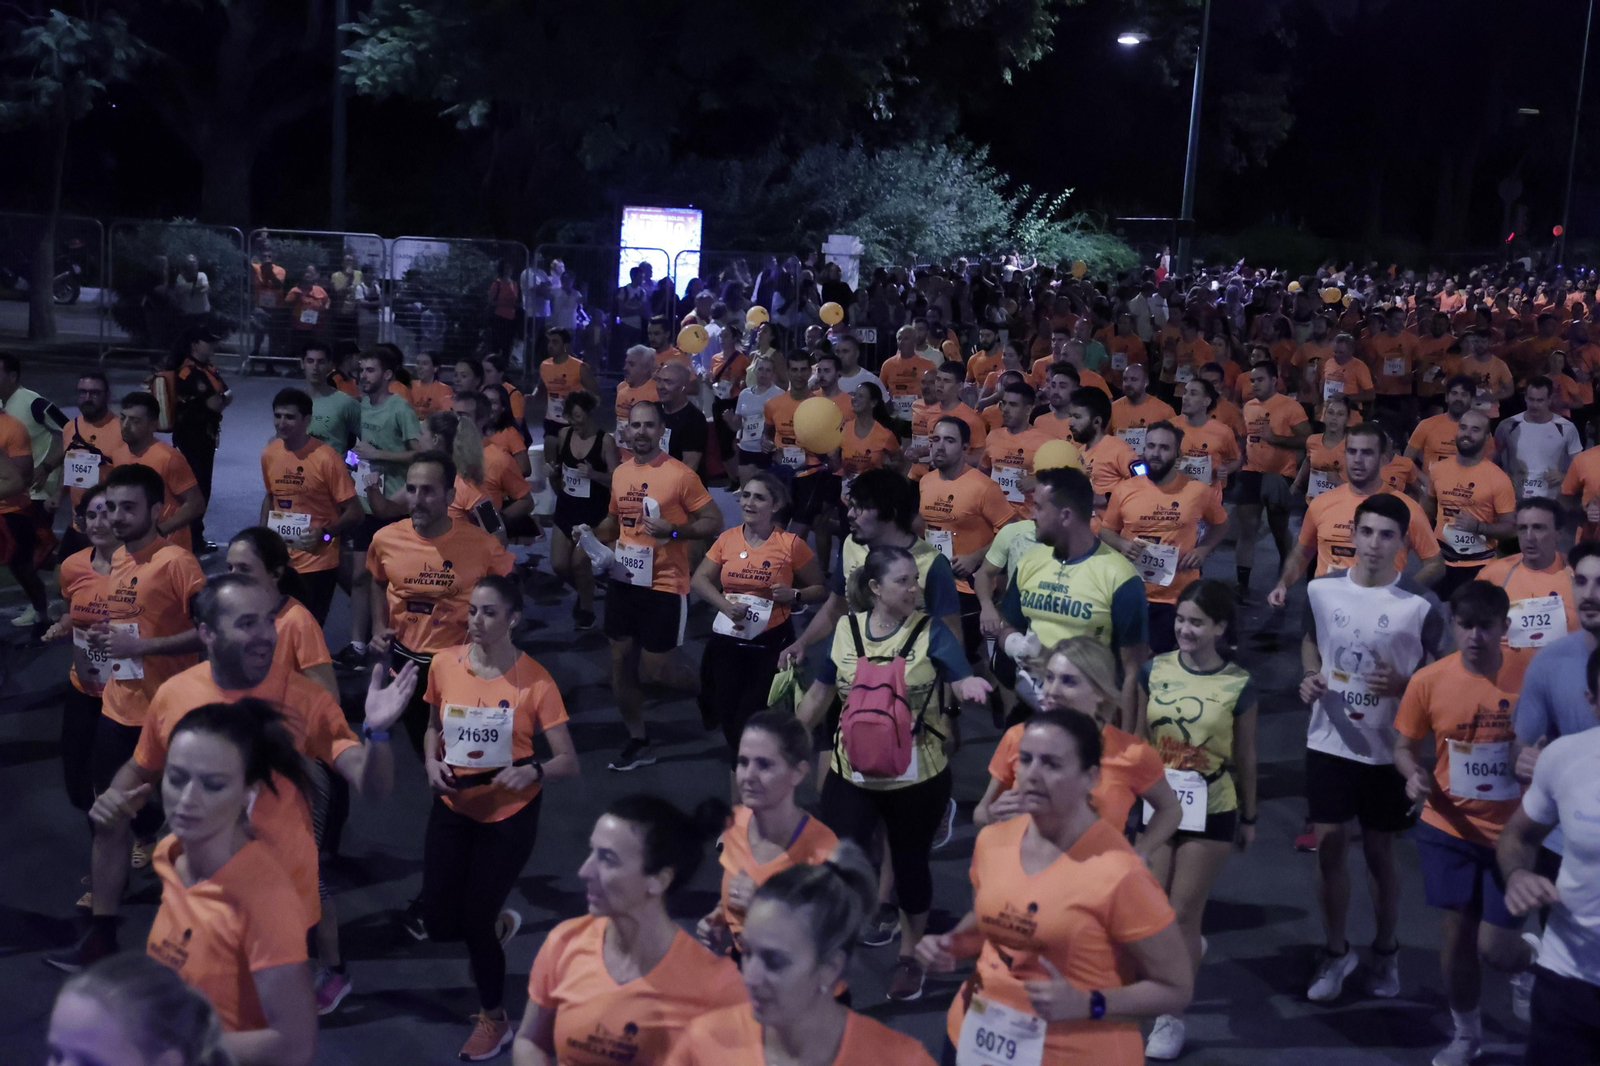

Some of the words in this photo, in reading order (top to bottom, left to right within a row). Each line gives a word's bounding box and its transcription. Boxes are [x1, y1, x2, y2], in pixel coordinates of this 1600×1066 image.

[71, 463, 93, 474] 15647
[277, 525, 301, 536] 16810
[1454, 534, 1476, 545] 3420
[620, 555, 645, 570] 19882
[1141, 555, 1165, 568] 3733
[403, 577, 434, 585] SEVILLA
[728, 571, 753, 580] SEVILLA
[1520, 614, 1557, 628] 3732
[1339, 690, 1380, 708] 16050
[457, 726, 499, 743] 21639
[1464, 761, 1507, 777] 16042
[975, 1026, 1017, 1060] 6079
